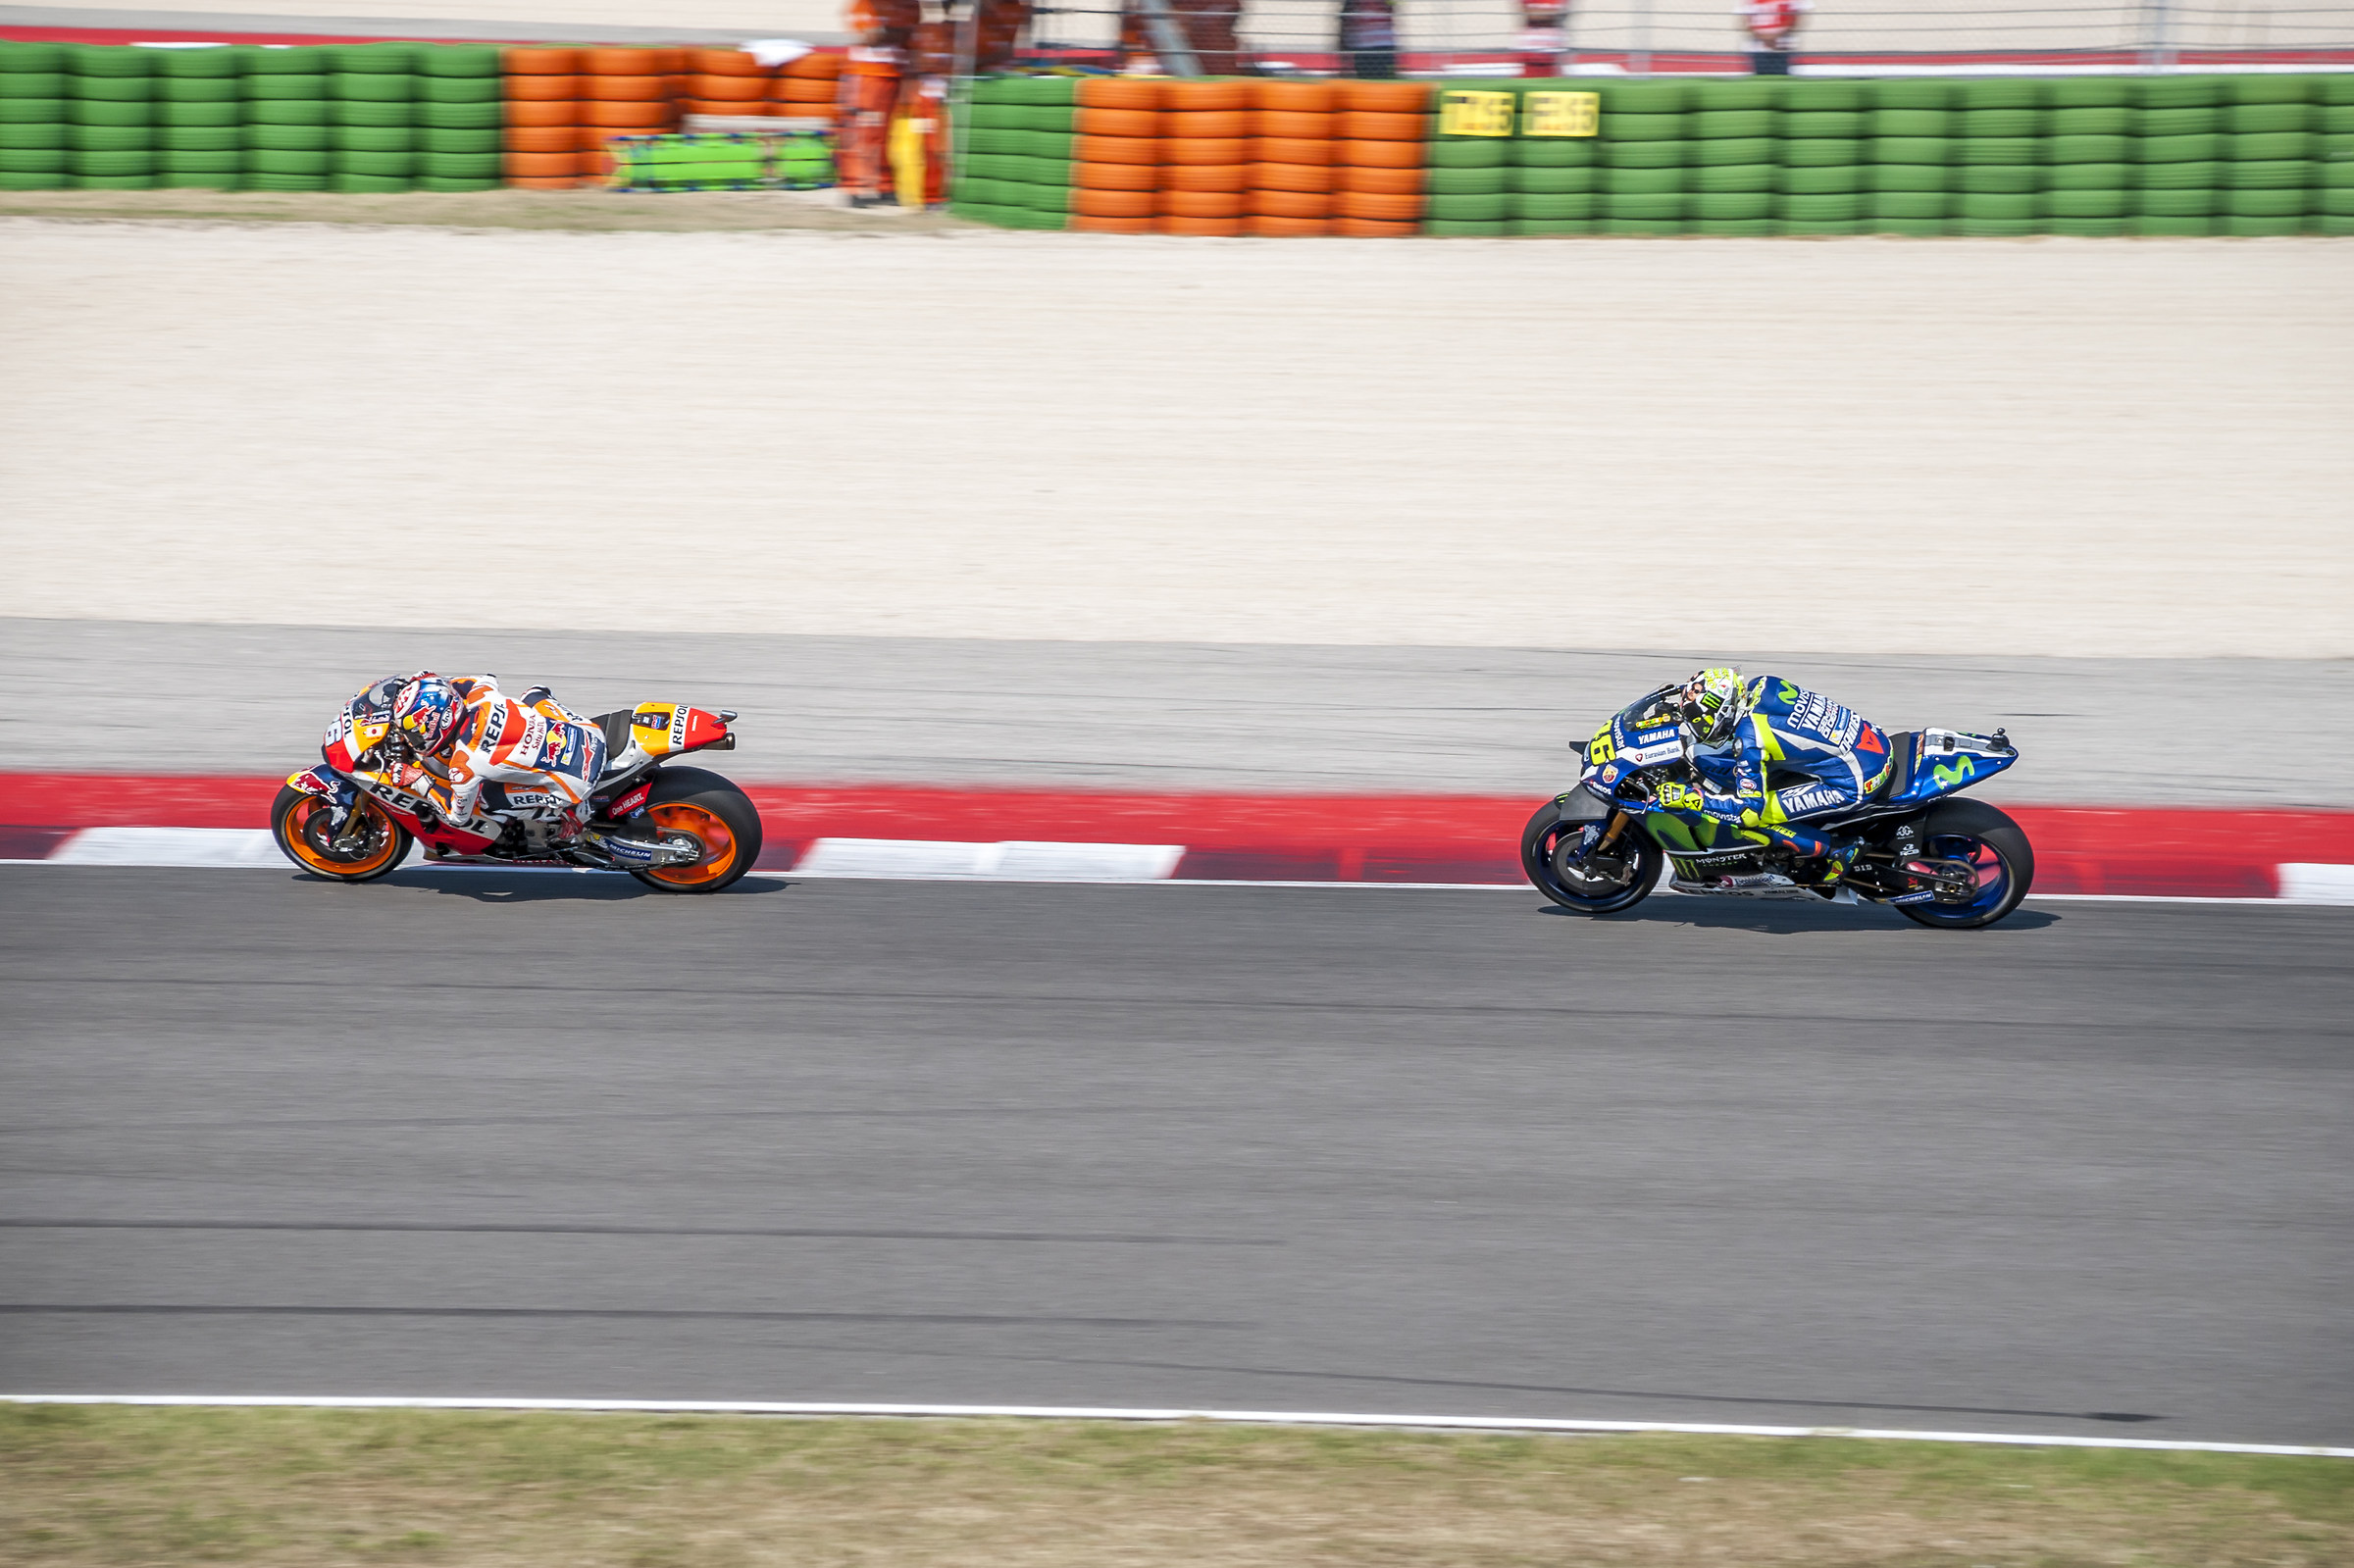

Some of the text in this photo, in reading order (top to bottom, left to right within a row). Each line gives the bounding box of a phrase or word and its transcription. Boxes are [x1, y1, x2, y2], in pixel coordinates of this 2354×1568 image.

[1787, 689, 1812, 729] movis
[479, 702, 507, 754] REPS
[1638, 729, 1675, 744] YAMAHA
[1645, 745, 1680, 760] Eurasian Bank
[1781, 789, 1845, 813] YAMAHA
[609, 844, 651, 858] MICHELIN
[1696, 853, 1747, 864] MONSTER
